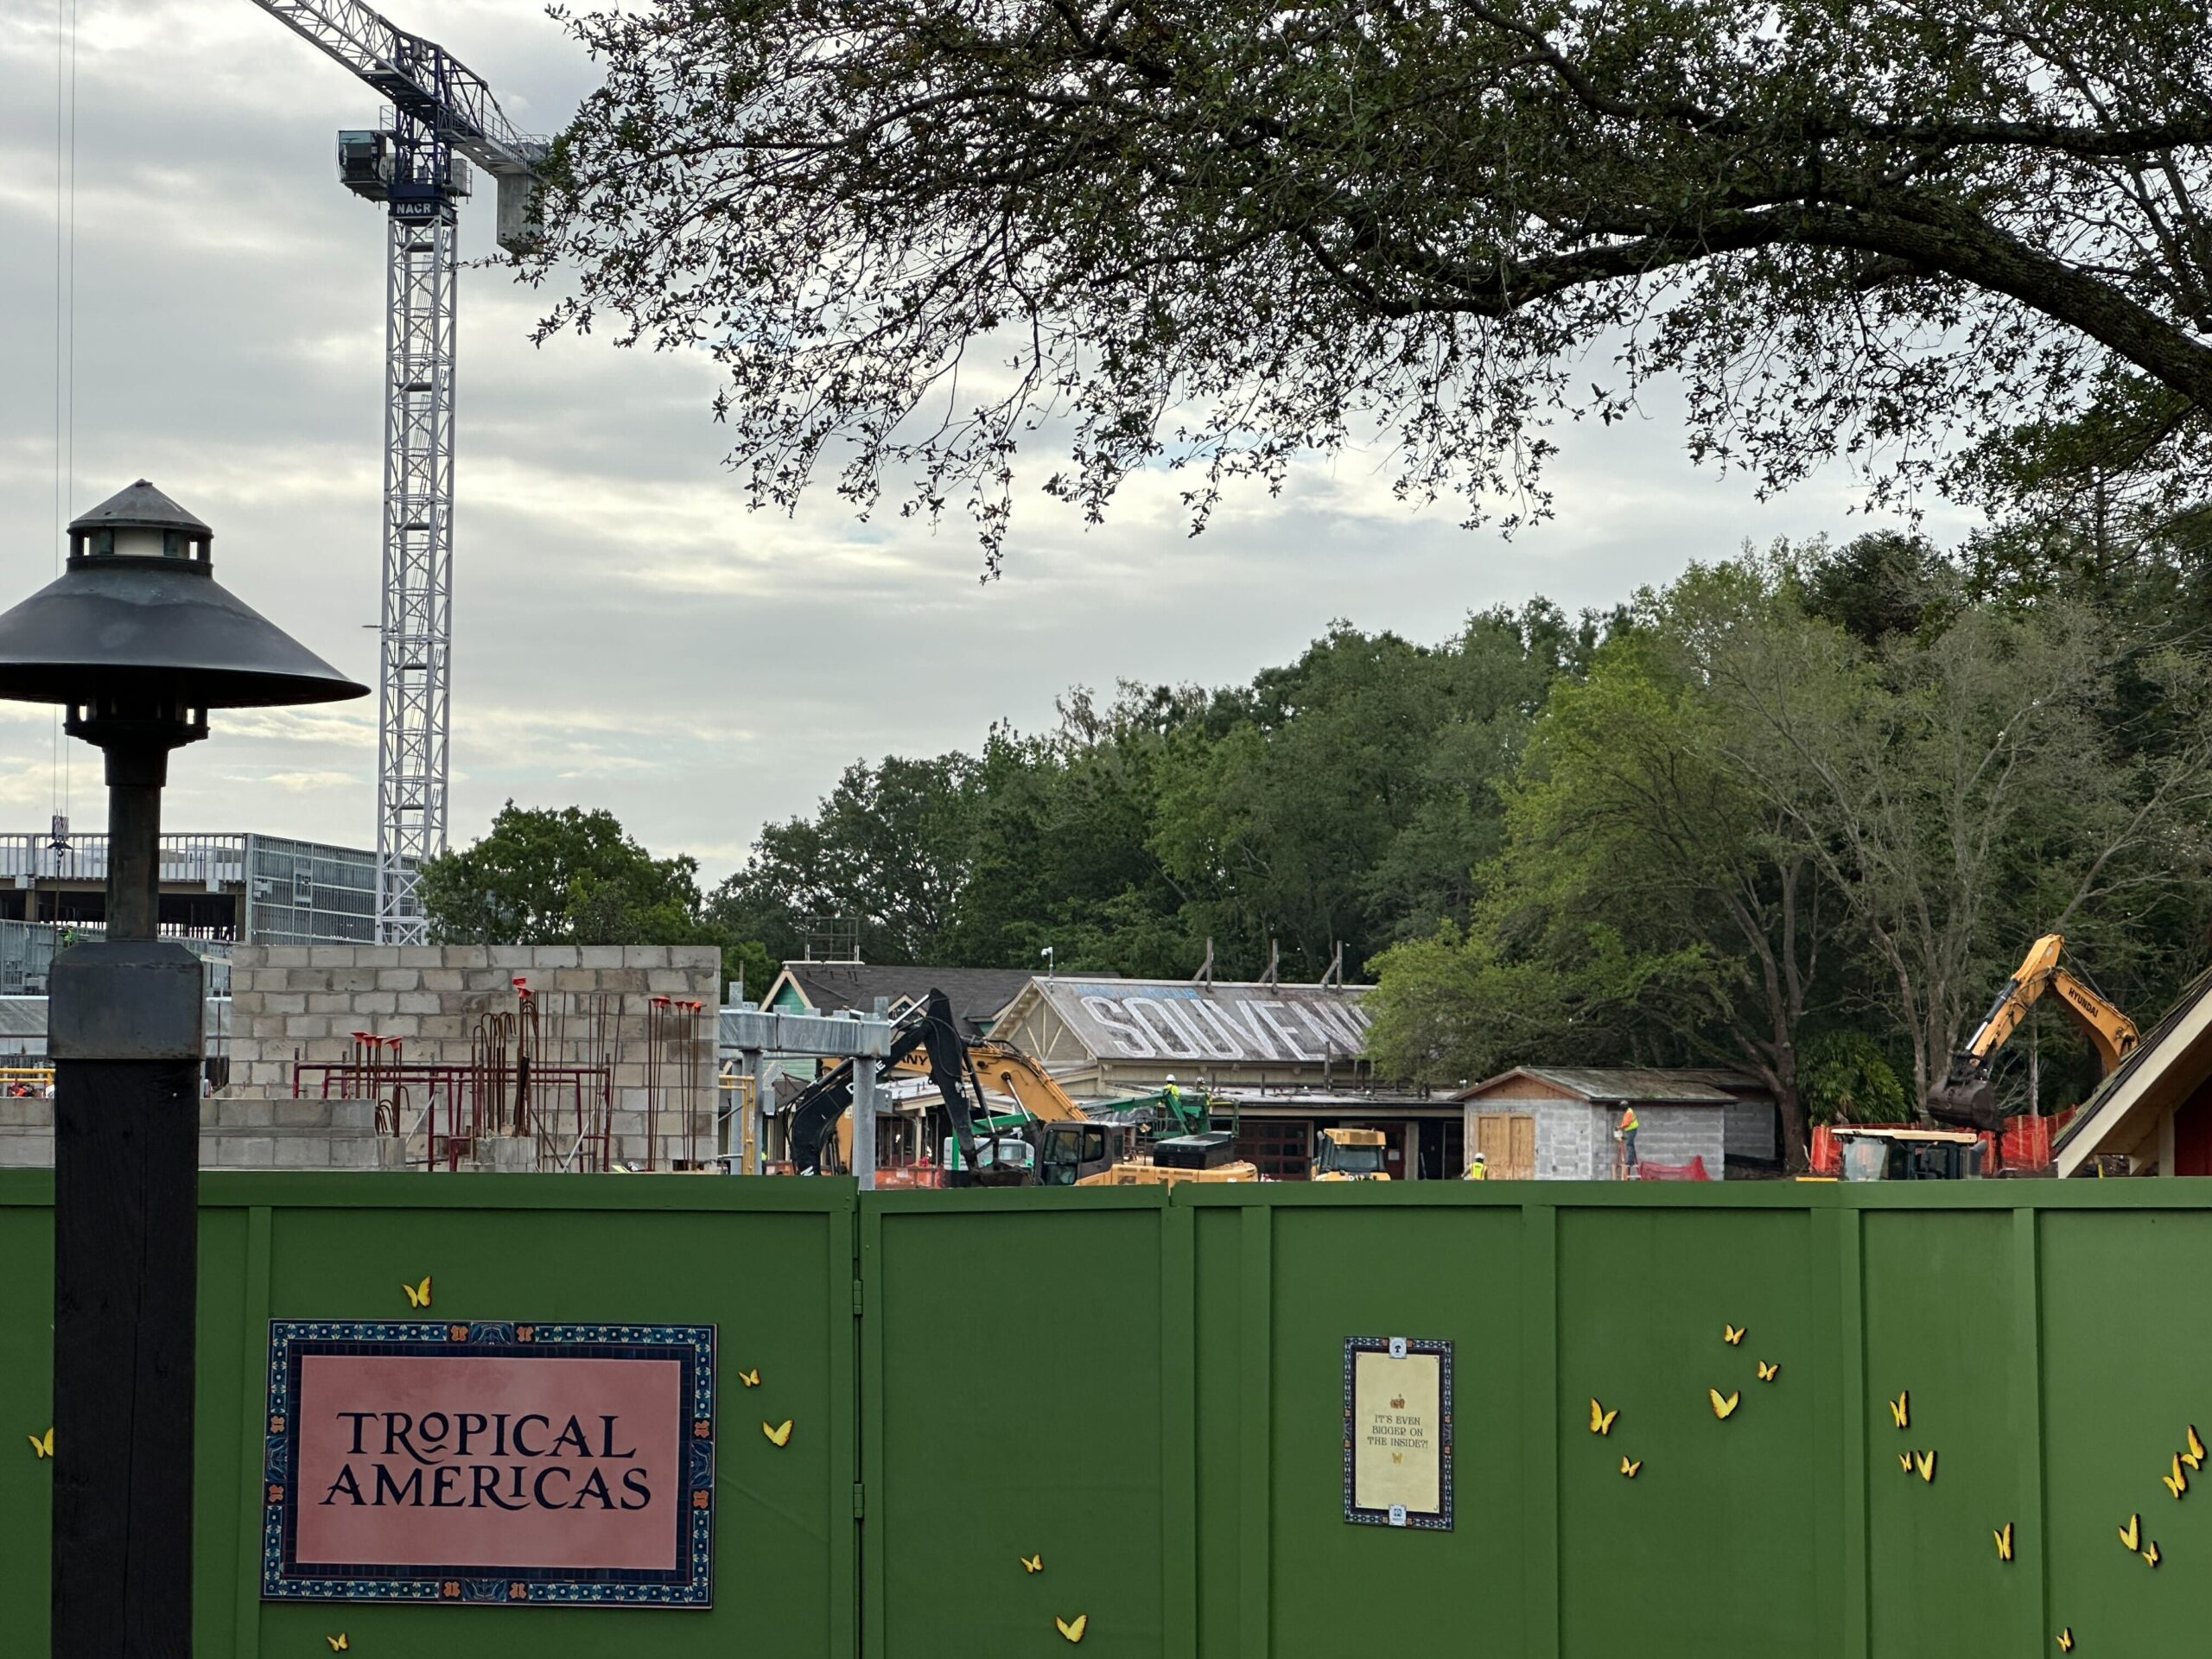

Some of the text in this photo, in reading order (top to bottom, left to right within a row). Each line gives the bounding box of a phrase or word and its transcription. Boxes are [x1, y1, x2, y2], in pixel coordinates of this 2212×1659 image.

[396, 203, 431, 214] NACR
[2068, 987, 2098, 1018] HYUNDAI
[1080, 995, 1372, 1061] SOUVENI
[1375, 1414, 1421, 1426] IT'S EVEN
[337, 1412, 637, 1465] TROPICAL
[1367, 1436, 1387, 1446] THE
[1372, 1426, 1423, 1437] BIGGER ON
[318, 1464, 651, 1511] AMERICAS
